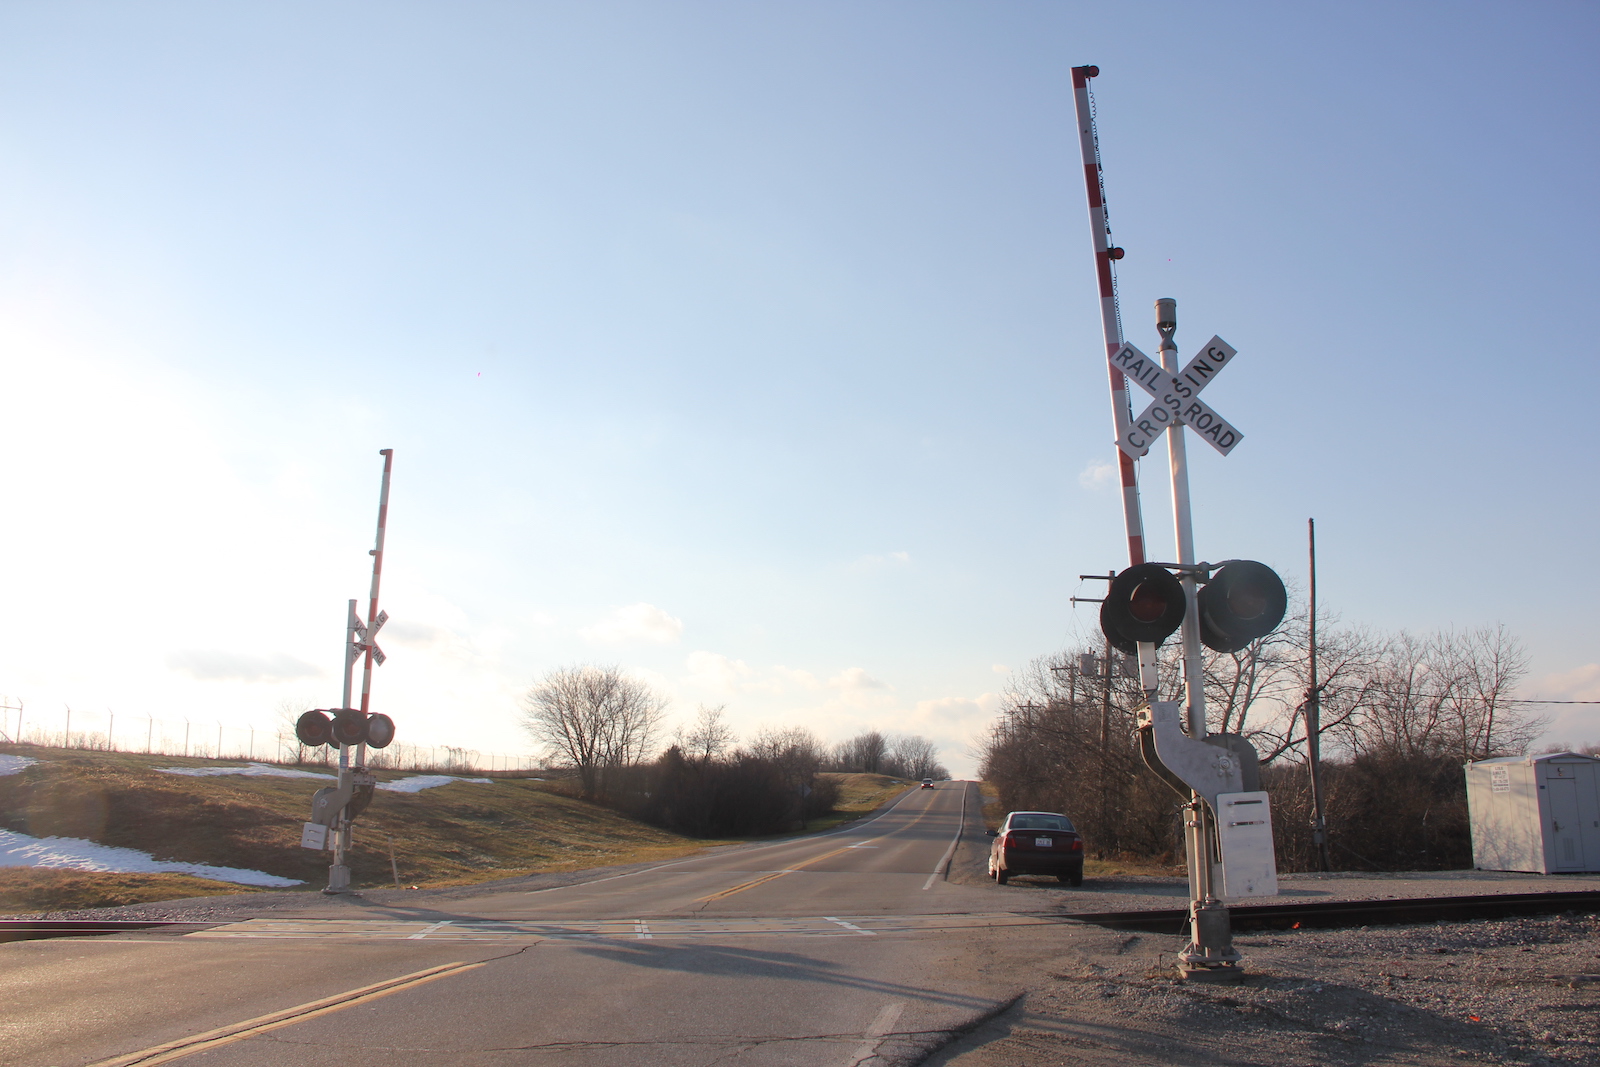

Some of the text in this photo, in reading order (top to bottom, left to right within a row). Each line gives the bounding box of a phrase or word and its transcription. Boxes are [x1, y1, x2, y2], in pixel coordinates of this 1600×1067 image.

[1115, 347, 1235, 449] RAIL ROAD
[1127, 346, 1226, 449] CROSSING
